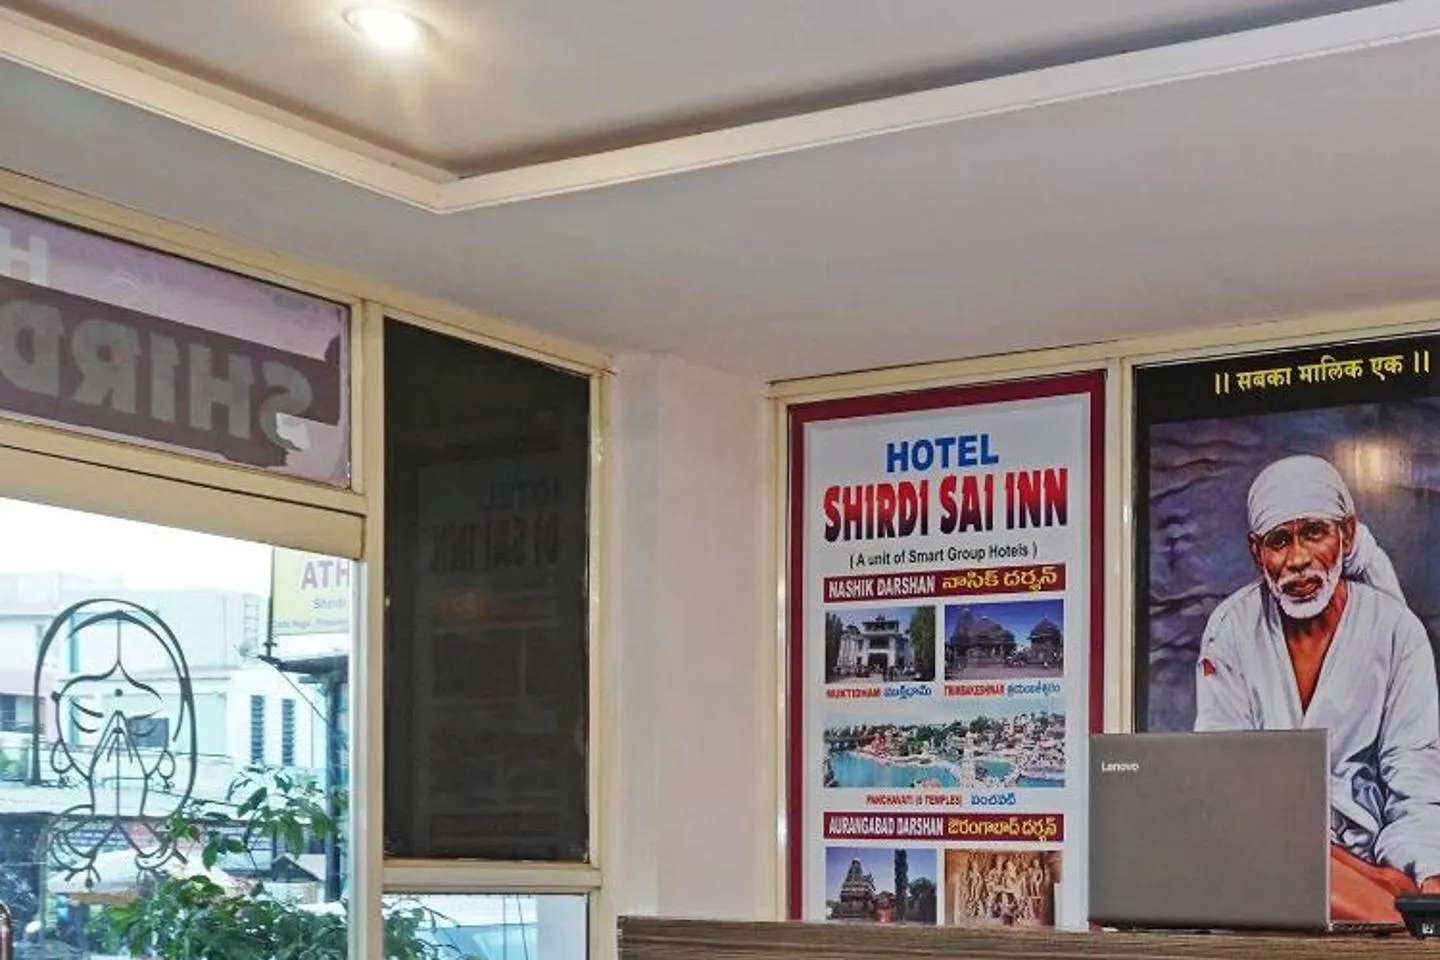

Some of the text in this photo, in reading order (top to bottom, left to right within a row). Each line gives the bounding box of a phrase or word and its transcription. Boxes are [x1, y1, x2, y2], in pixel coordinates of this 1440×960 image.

[1237, 366, 1293, 390] सबका
[1299, 355, 1363, 385] मालिक
[1370, 354, 1404, 382] एक
[886, 433, 999, 473] HOTEL
[823, 468, 1068, 543] SHIRDI SAI INN
[868, 555, 890, 566] unit
[894, 552, 906, 564] of
[908, 549, 944, 563] Smart
[948, 548, 986, 563] Group
[989, 544, 1028, 559] Hotels
[829, 575, 936, 599] NASHIK DARSHAN
[1101, 761, 1139, 772] Lenovo
[829, 816, 944, 836] AURANGABAD DARSHAN
